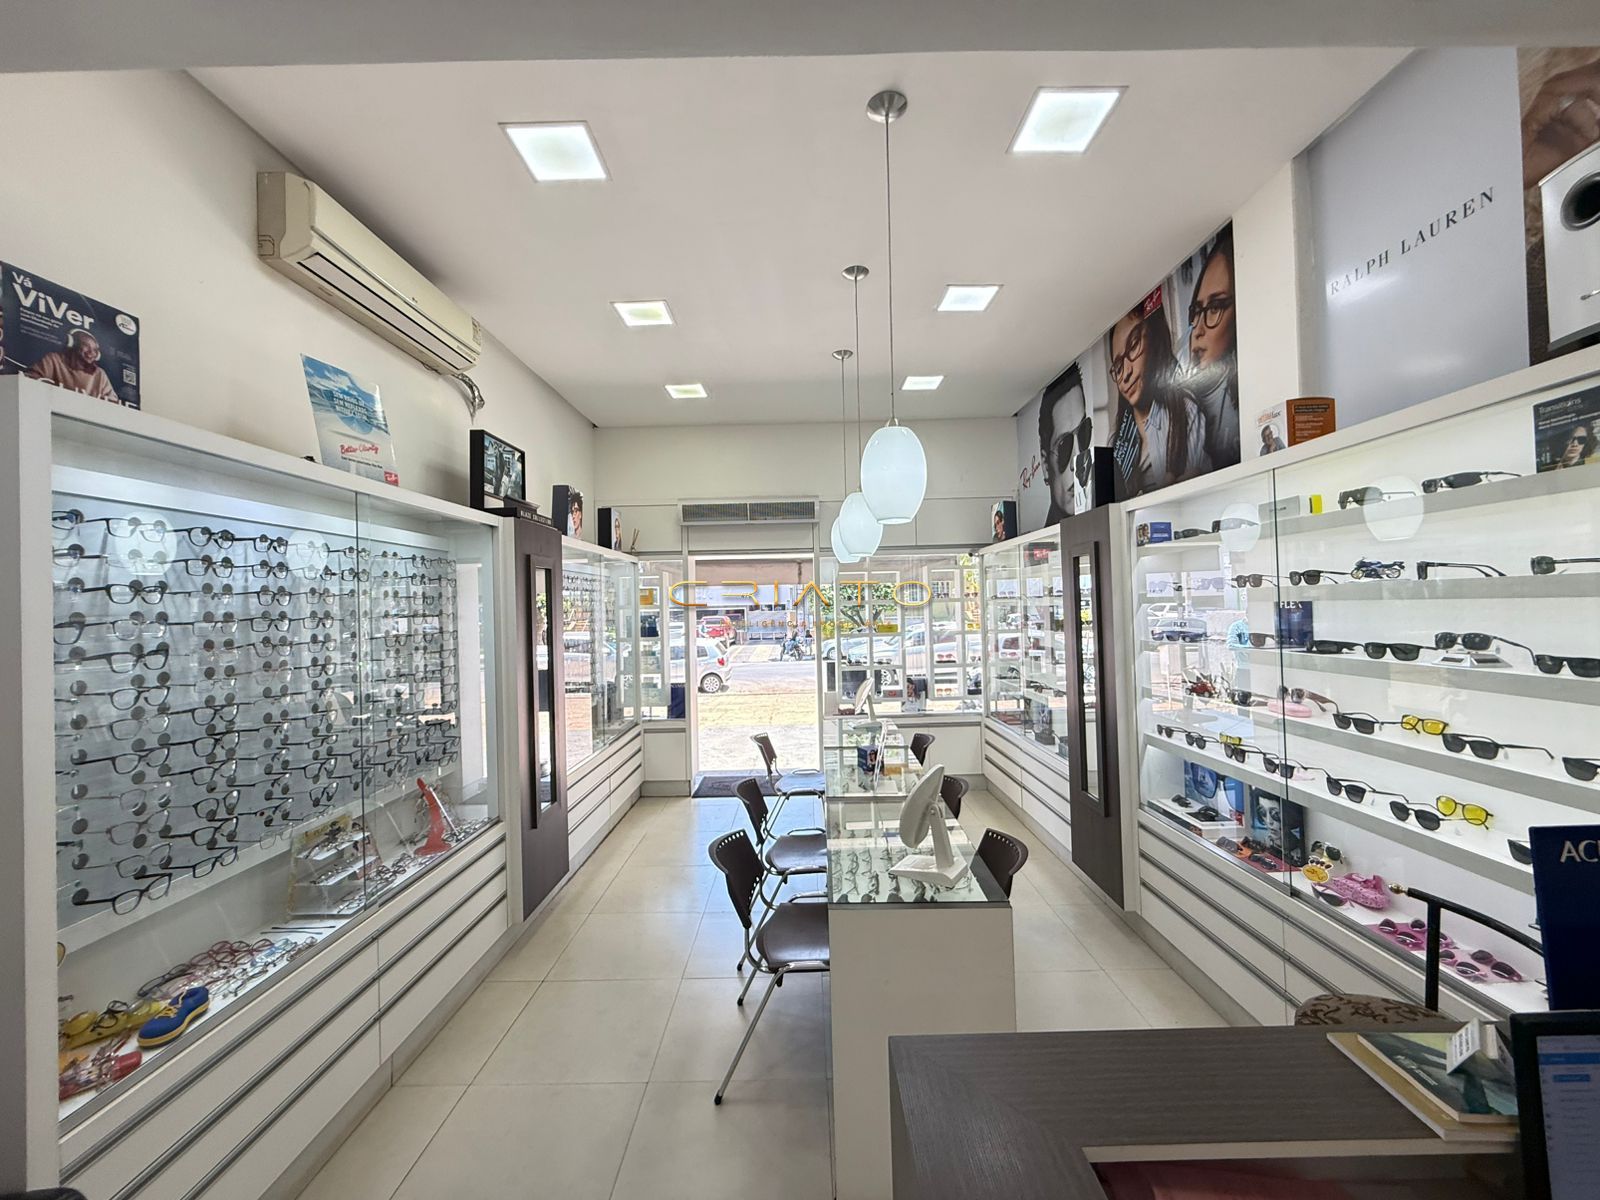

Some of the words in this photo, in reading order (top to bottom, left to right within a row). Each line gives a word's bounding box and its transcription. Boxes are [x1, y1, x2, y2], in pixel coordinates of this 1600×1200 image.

[1330, 248, 1391, 296] RALPH
[1400, 186, 1496, 255] LAUREN
[11, 282, 95, 330] ViVer
[1279, 600, 1303, 608] FLEX
[1560, 839, 1600, 863] AC
